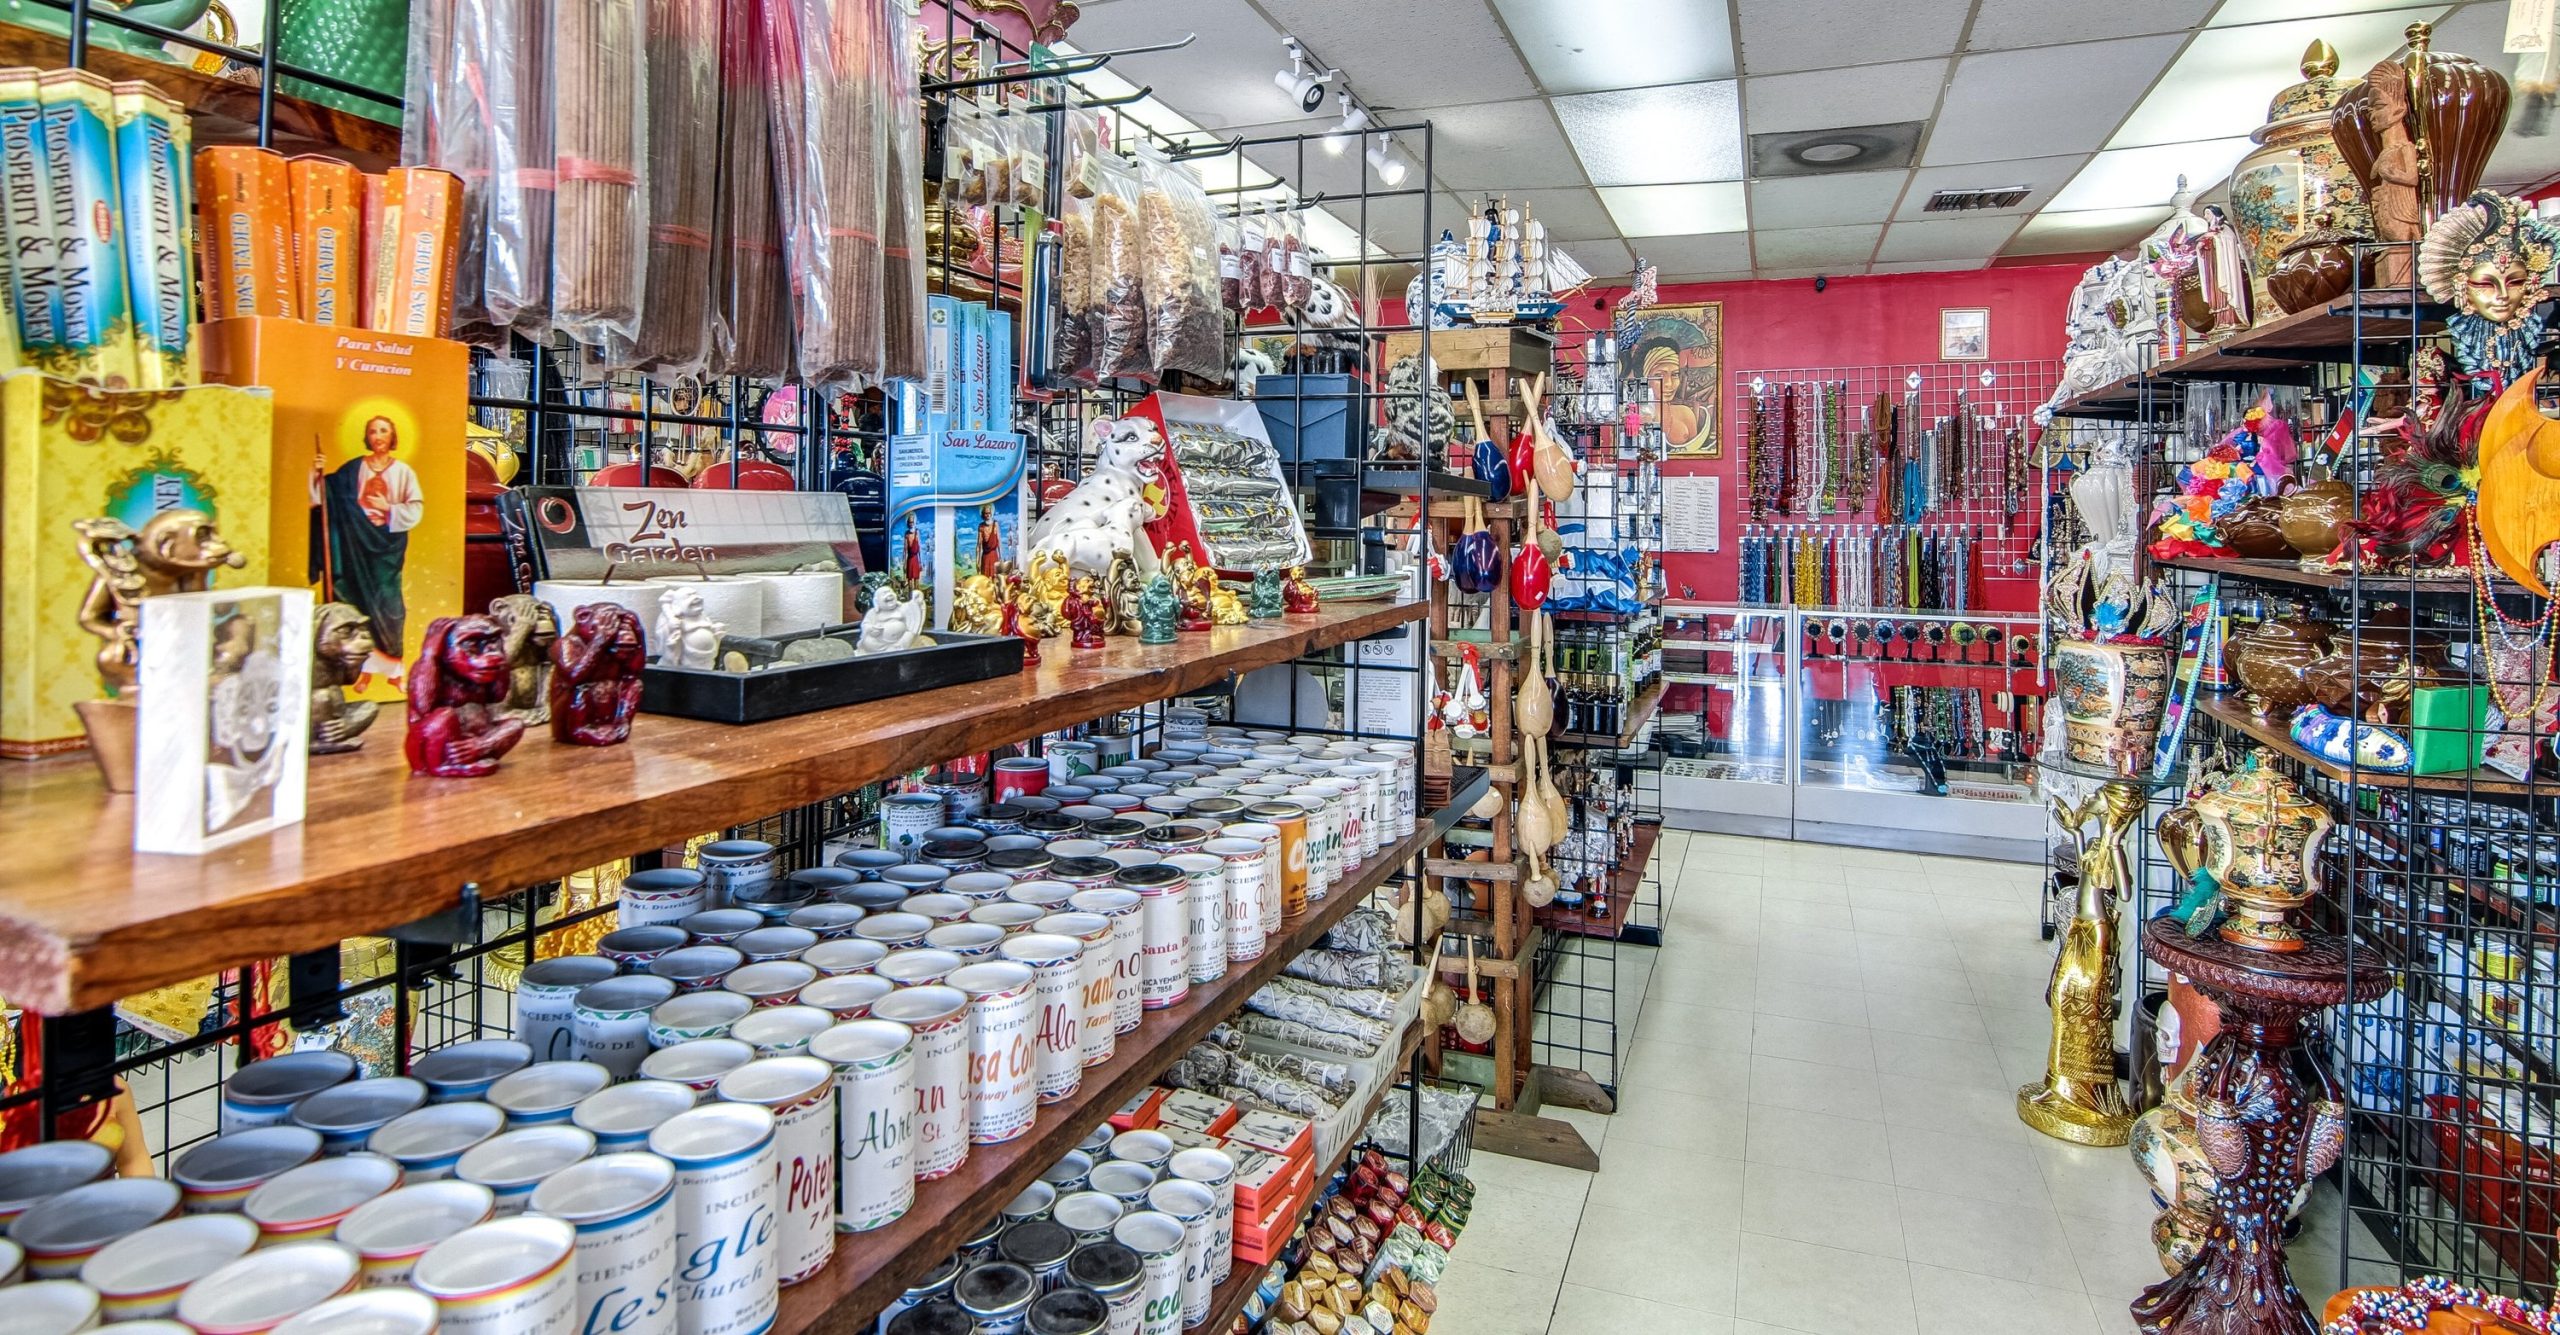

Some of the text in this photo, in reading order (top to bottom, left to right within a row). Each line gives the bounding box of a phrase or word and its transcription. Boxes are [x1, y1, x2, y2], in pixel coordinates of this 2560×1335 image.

[4, 105, 57, 343] PROSPERITY & MONEY
[45, 104, 90, 343] PROSPERITY & MONEY
[149, 120, 182, 350] PROSPERITY & MONEY
[231, 212, 254, 270] TADEO
[317, 226, 336, 284] TADEO
[412, 231, 434, 287] TADEO
[335, 335, 414, 356] Para Salud
[335, 355, 412, 376] Y Curacion
[951, 333, 959, 384] Lazaro
[972, 334, 984, 385] Lazaro
[951, 387, 959, 417] San
[972, 387, 984, 417] San
[942, 431, 971, 448] San
[973, 432, 1017, 451] Lazaro
[502, 507, 527, 559] Zen
[622, 499, 688, 544] Zen
[603, 537, 717, 565] Garden
[1142, 943, 1178, 957] Santa
[611, 1040, 636, 1051] DE
[1036, 1002, 1077, 1054] Ala
[842, 1108, 912, 1161] Abre
[679, 1203, 774, 1283] gle
[809, 1212, 820, 1231] 7
